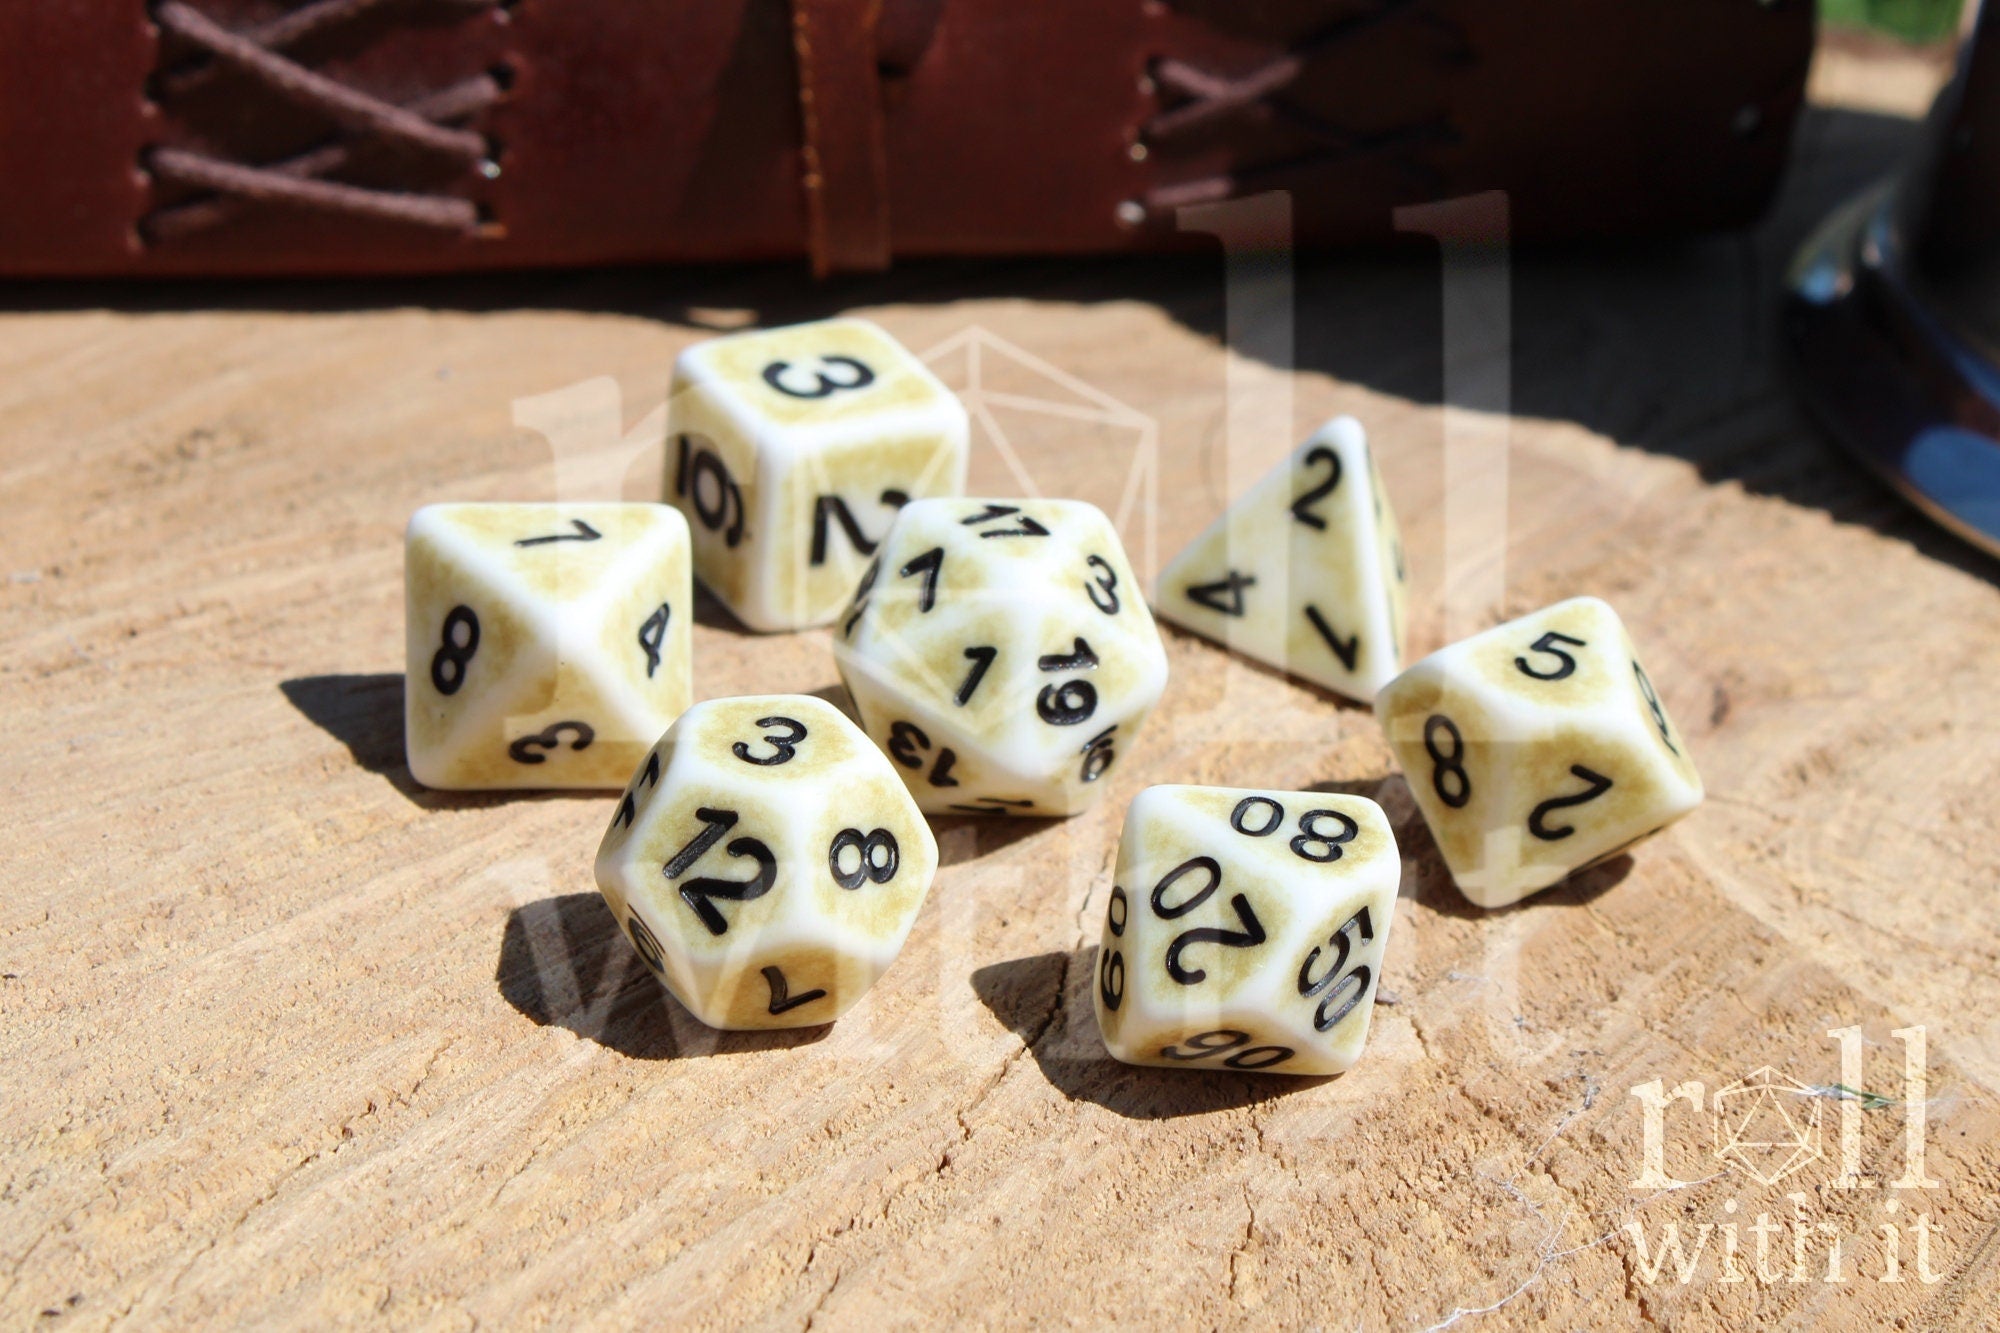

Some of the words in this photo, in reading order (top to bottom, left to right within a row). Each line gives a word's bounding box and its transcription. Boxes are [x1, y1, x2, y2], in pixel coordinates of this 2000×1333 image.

[762, 356, 875, 399] 3
[1290, 447, 1342, 531] 2
[1085, 555, 1120, 614] 3
[1187, 570, 1257, 616] 4
[431, 605, 480, 695] 8
[638, 602, 671, 678] 4
[1515, 631, 1586, 680] 5
[954, 646, 998, 707] 1
[1037, 637, 1099, 726] 19
[509, 721, 595, 764] 3
[732, 716, 808, 766] 3
[887, 720, 959, 787] 13
[1424, 714, 1471, 808] 8
[1231, 796, 1358, 863] 80
[1528, 764, 1613, 841] 2
[663, 807, 777, 935] 12
[828, 828, 900, 891] 8
[1100, 886, 1127, 1012] 60
[1151, 856, 1266, 986] 20
[1297, 905, 1374, 1033] 50
[1162, 1029, 1295, 1069] 90
